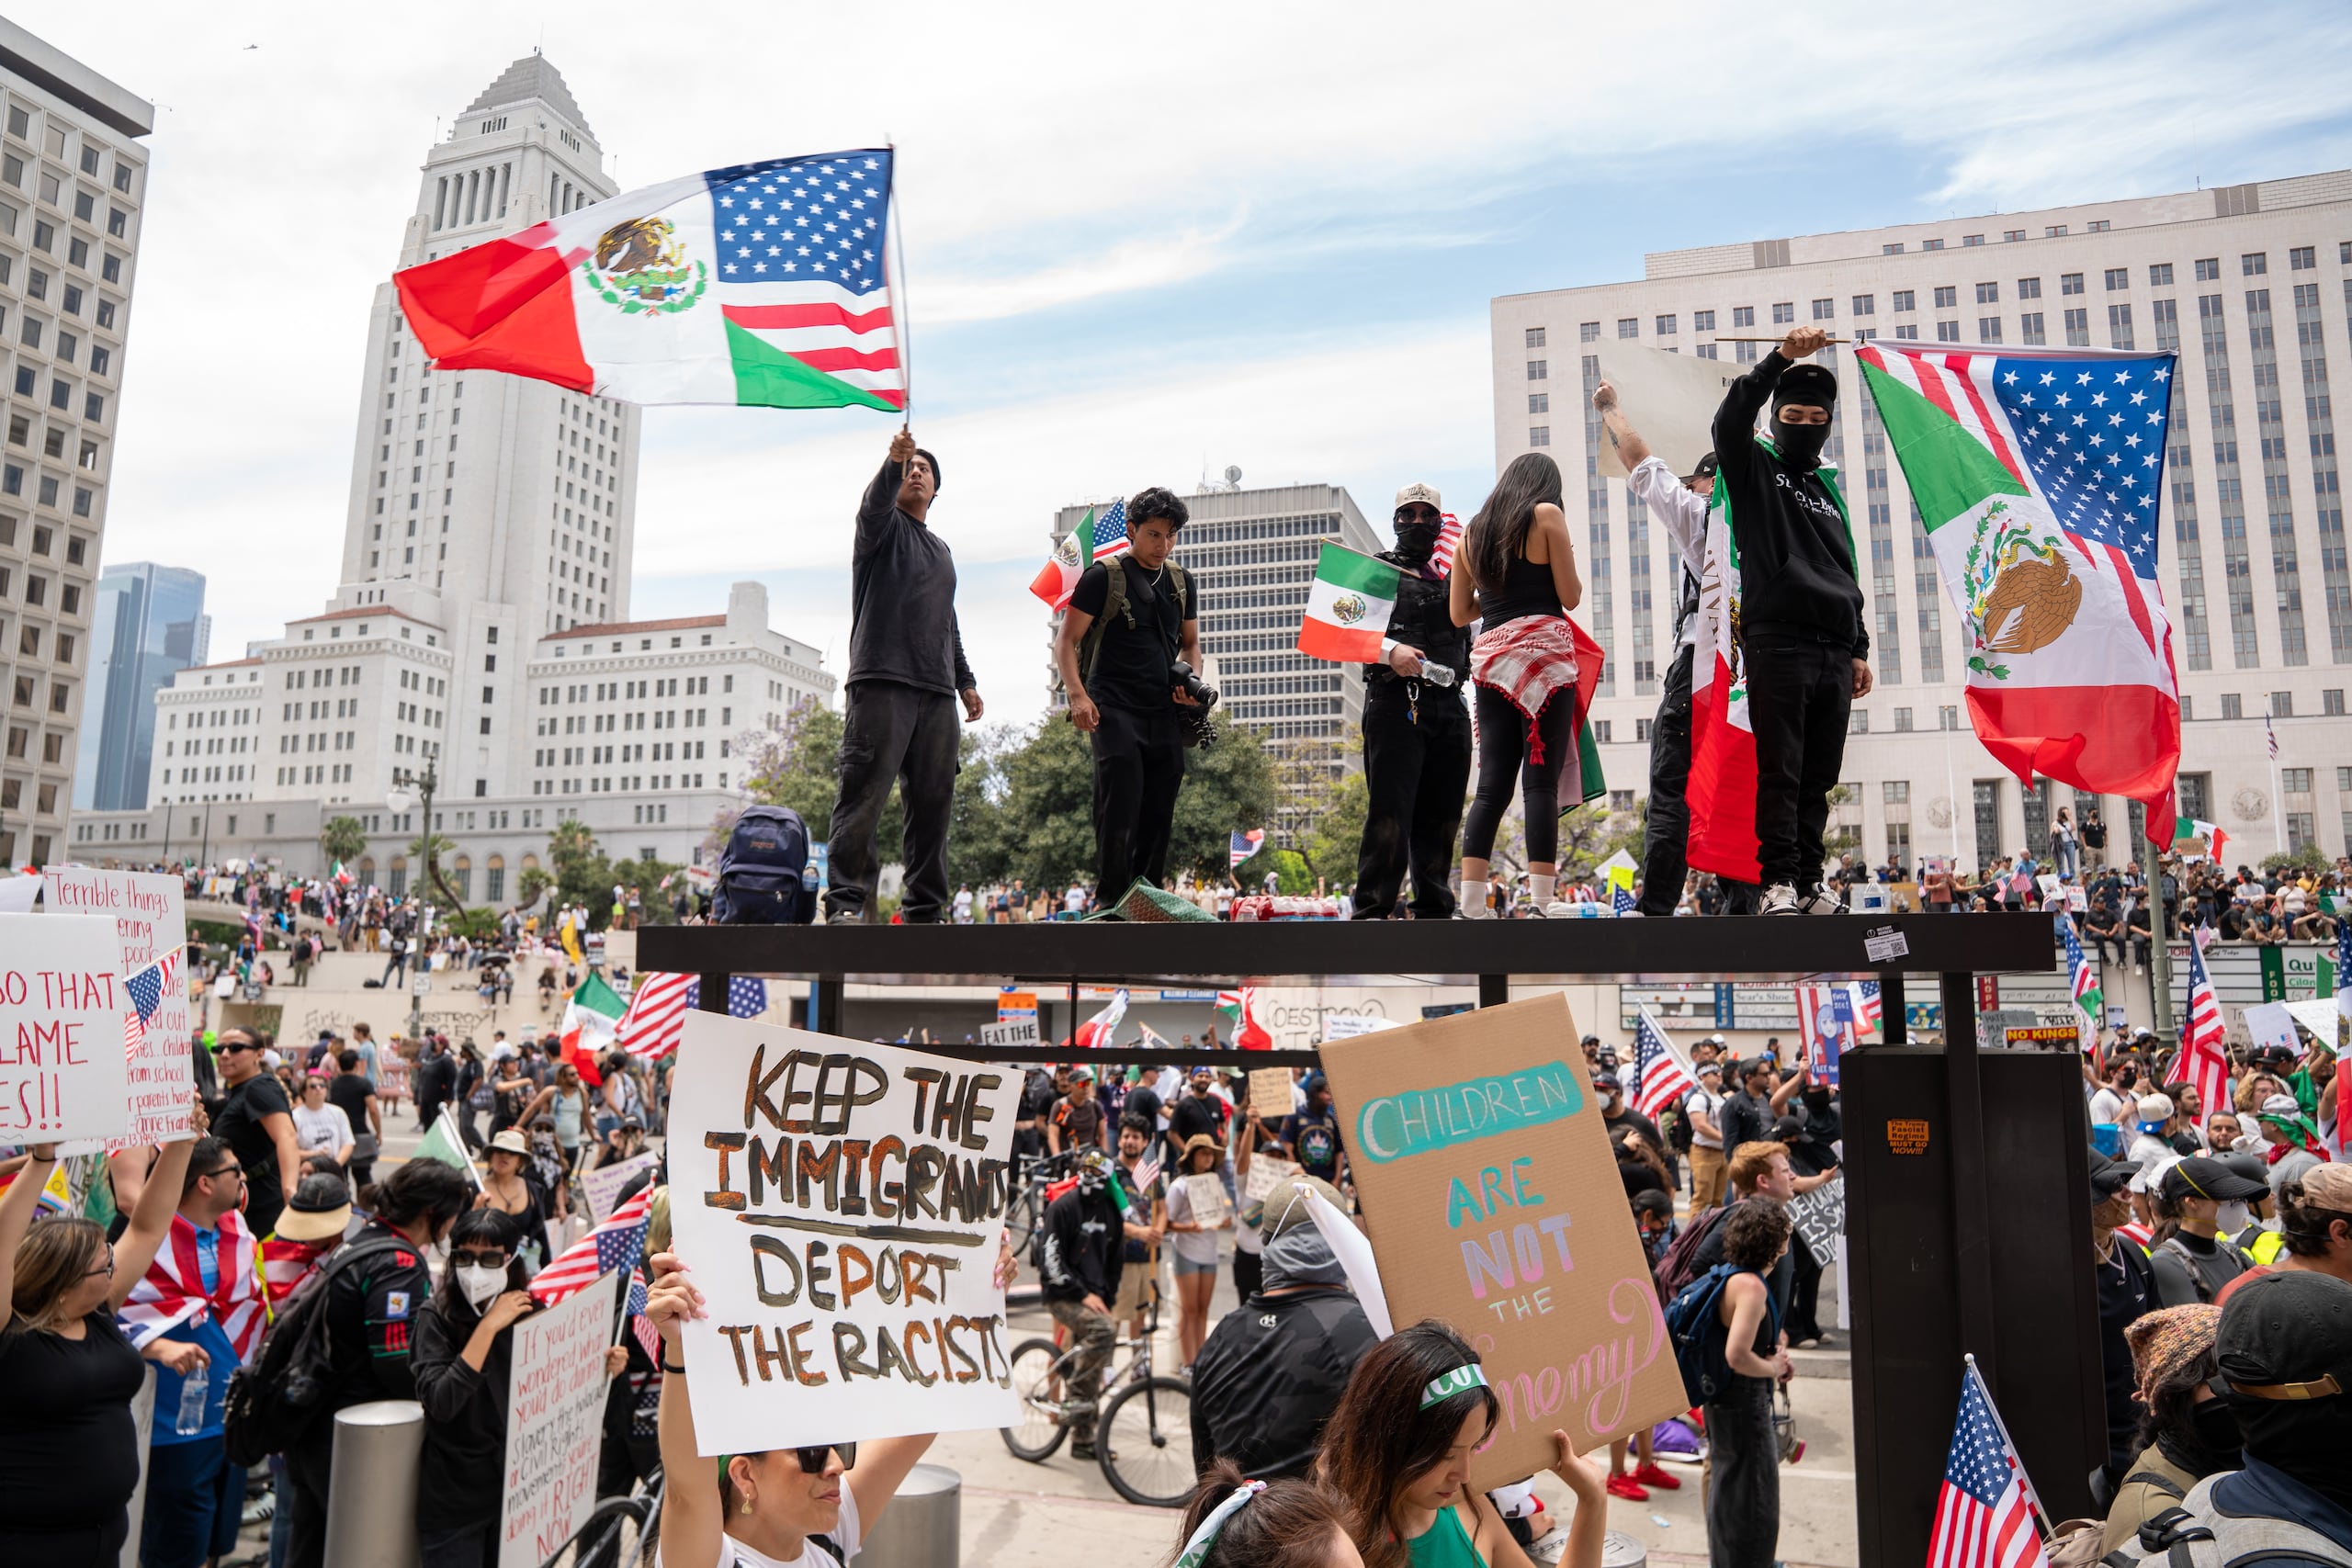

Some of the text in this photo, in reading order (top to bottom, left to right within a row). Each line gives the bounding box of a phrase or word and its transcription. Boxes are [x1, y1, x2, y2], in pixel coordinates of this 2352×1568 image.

[125, 878, 169, 919] things
[37, 971, 115, 1010] THAT
[1736, 993, 1790, 1001] Sear's Shoe
[2268, 970, 2279, 1003] FOO
[2289, 977, 2316, 987] Cilan
[166, 1006, 187, 1032] out
[403, 1010, 497, 1030] ESTROY!
[984, 1023, 1036, 1046] EAT THE
[2007, 1027, 2077, 1040] NO KINGS
[127, 1061, 185, 1086] from school
[136, 1091, 169, 1115] parents
[171, 1086, 191, 1105] have
[743, 1043, 1002, 1151] KEEP THE
[1363, 1069, 1568, 1158] CHILDREN
[128, 1134, 138, 1147] 13
[1446, 1156, 1545, 1229] ARE
[1800, 1214, 1827, 1243] IS
[750, 1234, 962, 1312] DEPORT
[1460, 1212, 1575, 1301] NOT
[1487, 1286, 1556, 1325] THE
[518, 1296, 607, 1367] If you'd ever
[718, 1313, 1012, 1389] THE RACISTS
[517, 1325, 605, 1397] wondered what
[1473, 1278, 1666, 1455] nemy
[550, 1377, 566, 1404] do
[553, 1452, 598, 1517] RIGHT
[537, 1511, 571, 1566] NOW
